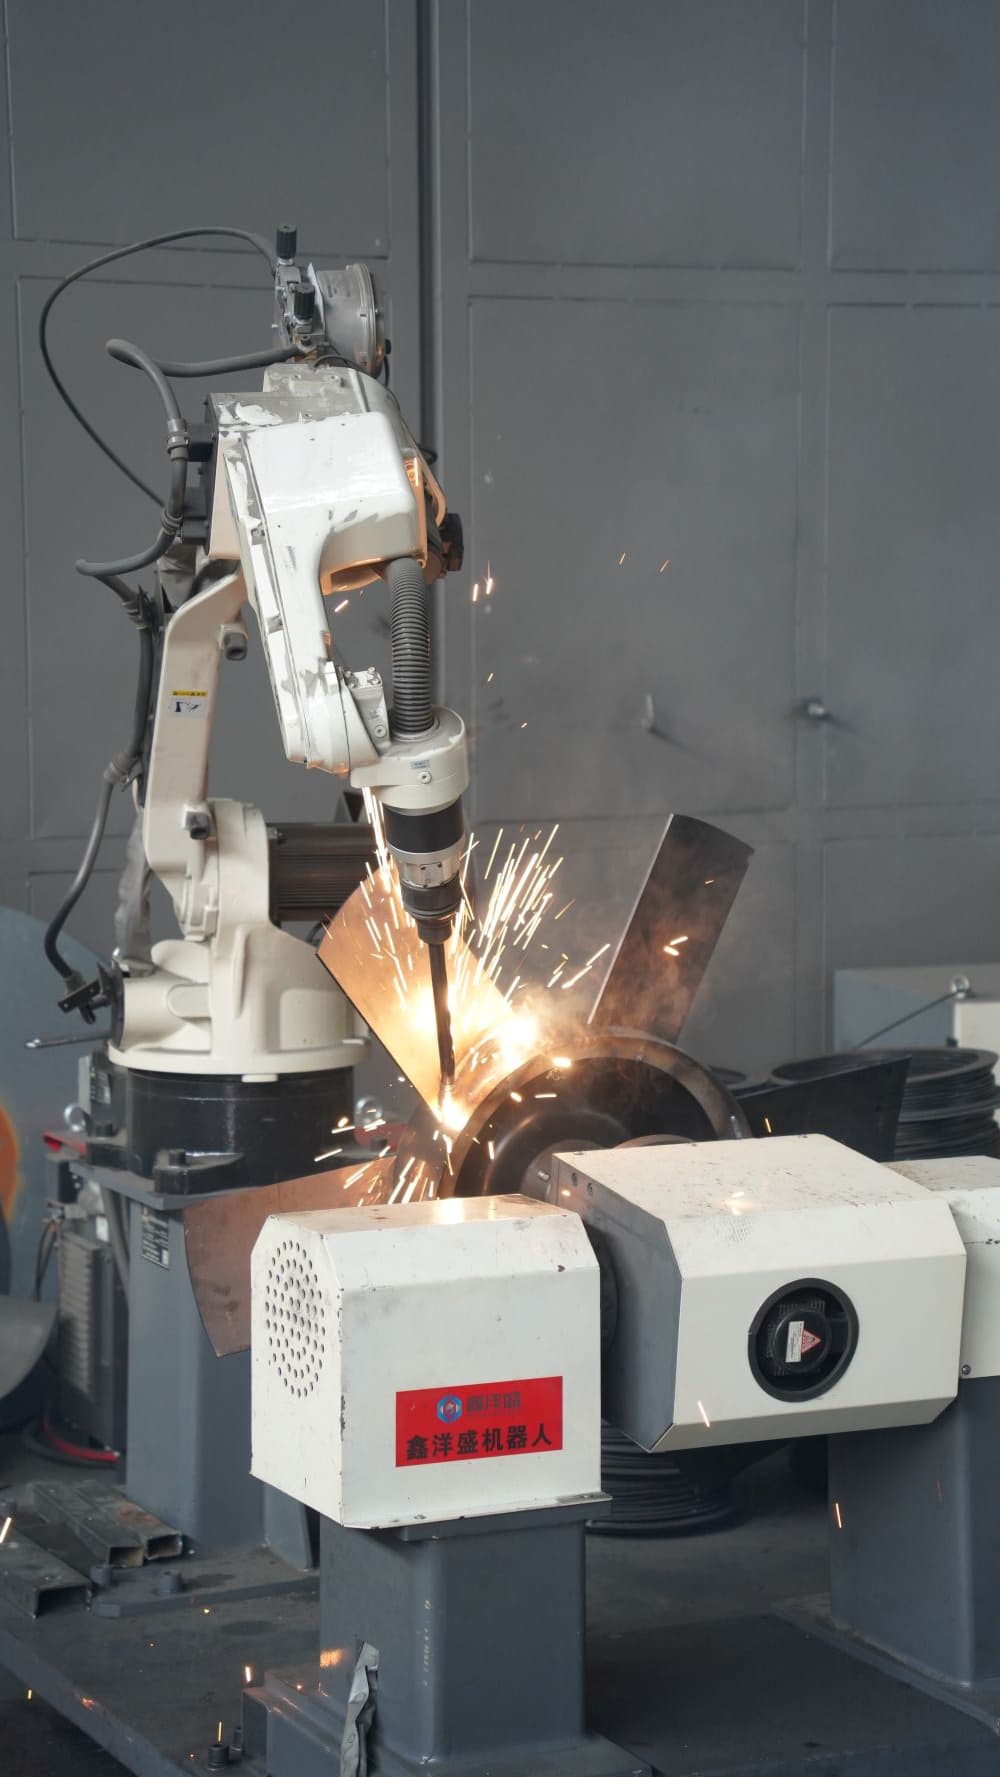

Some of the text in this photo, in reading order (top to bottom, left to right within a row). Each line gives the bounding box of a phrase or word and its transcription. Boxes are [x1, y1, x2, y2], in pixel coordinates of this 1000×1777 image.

[406, 1423, 552, 1460] 鑫洋盛机器人
